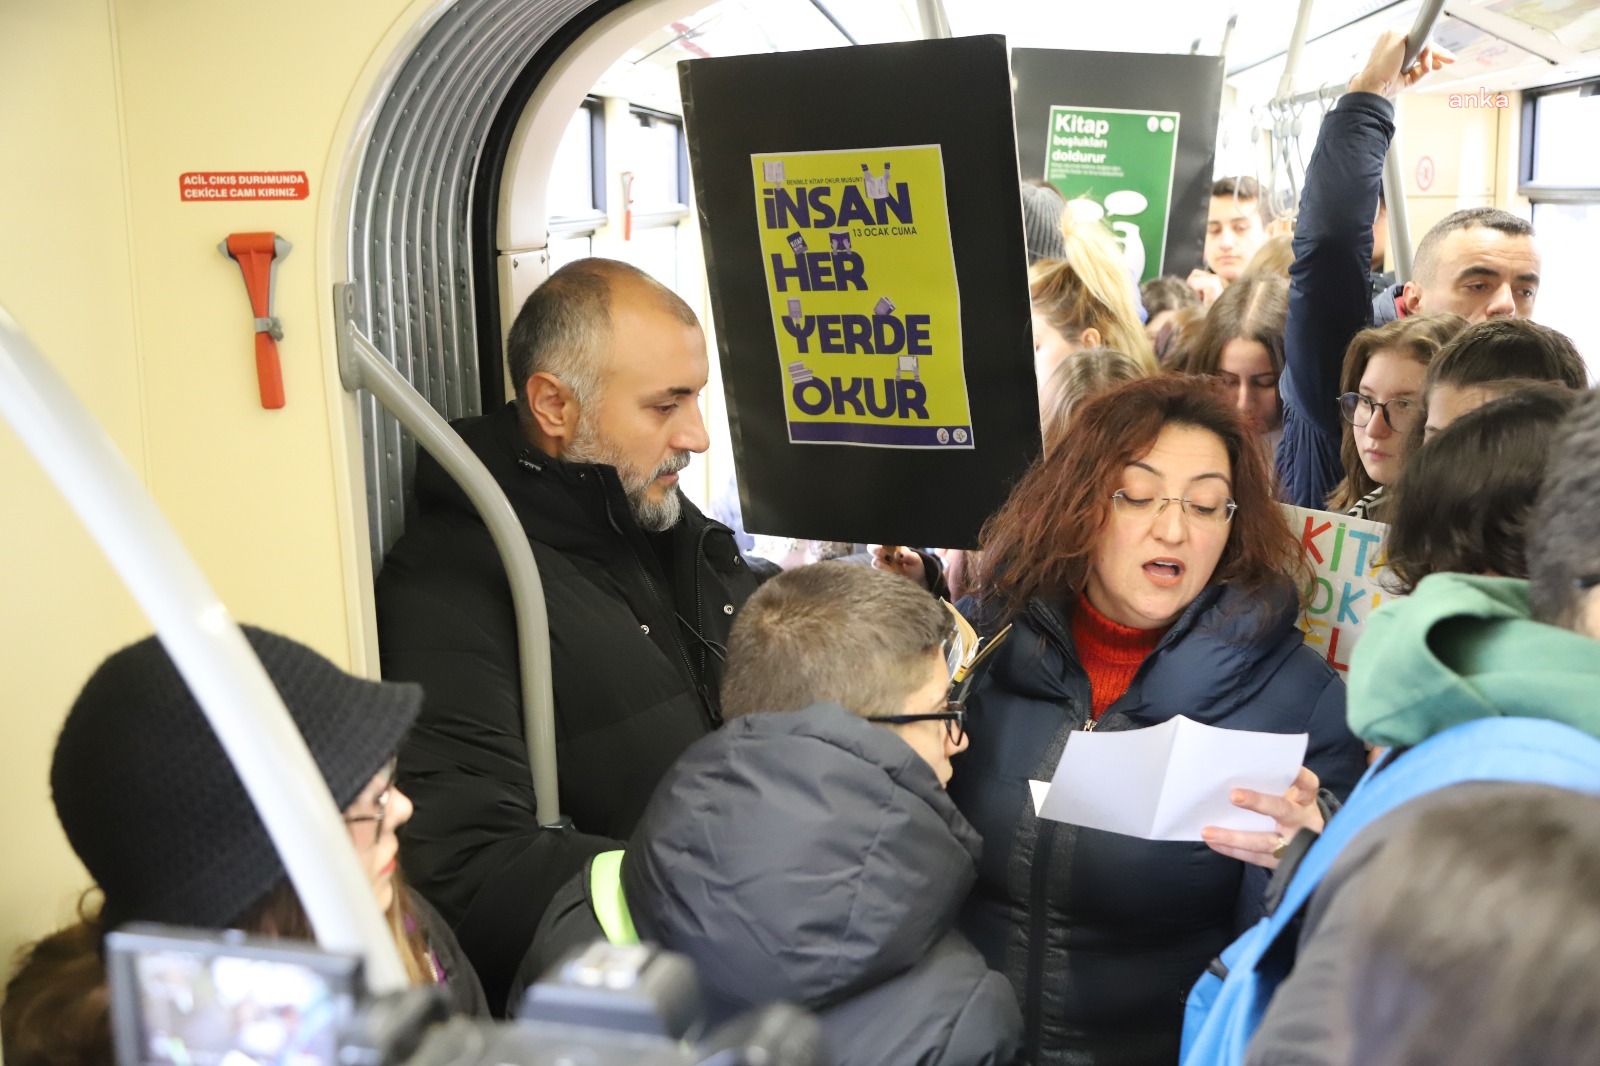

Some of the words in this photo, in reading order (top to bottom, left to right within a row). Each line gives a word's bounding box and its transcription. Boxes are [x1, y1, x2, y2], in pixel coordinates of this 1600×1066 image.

[1055, 113, 1109, 138] Kitap
[1051, 149, 1107, 164] doldurur
[184, 174, 208, 185] ACİL
[238, 175, 304, 185] DURUMUNDA
[184, 187, 228, 198] ÇEKİÇLE
[229, 188, 256, 197] CAMI
[257, 187, 298, 197] KIRINIZ.
[853, 228, 863, 237] 13
[864, 227, 889, 237] OCAK
[891, 226, 918, 236] CUMA
[771, 251, 868, 292] HER
[781, 314, 932, 355] YERDE
[792, 376, 930, 419] OKUR
